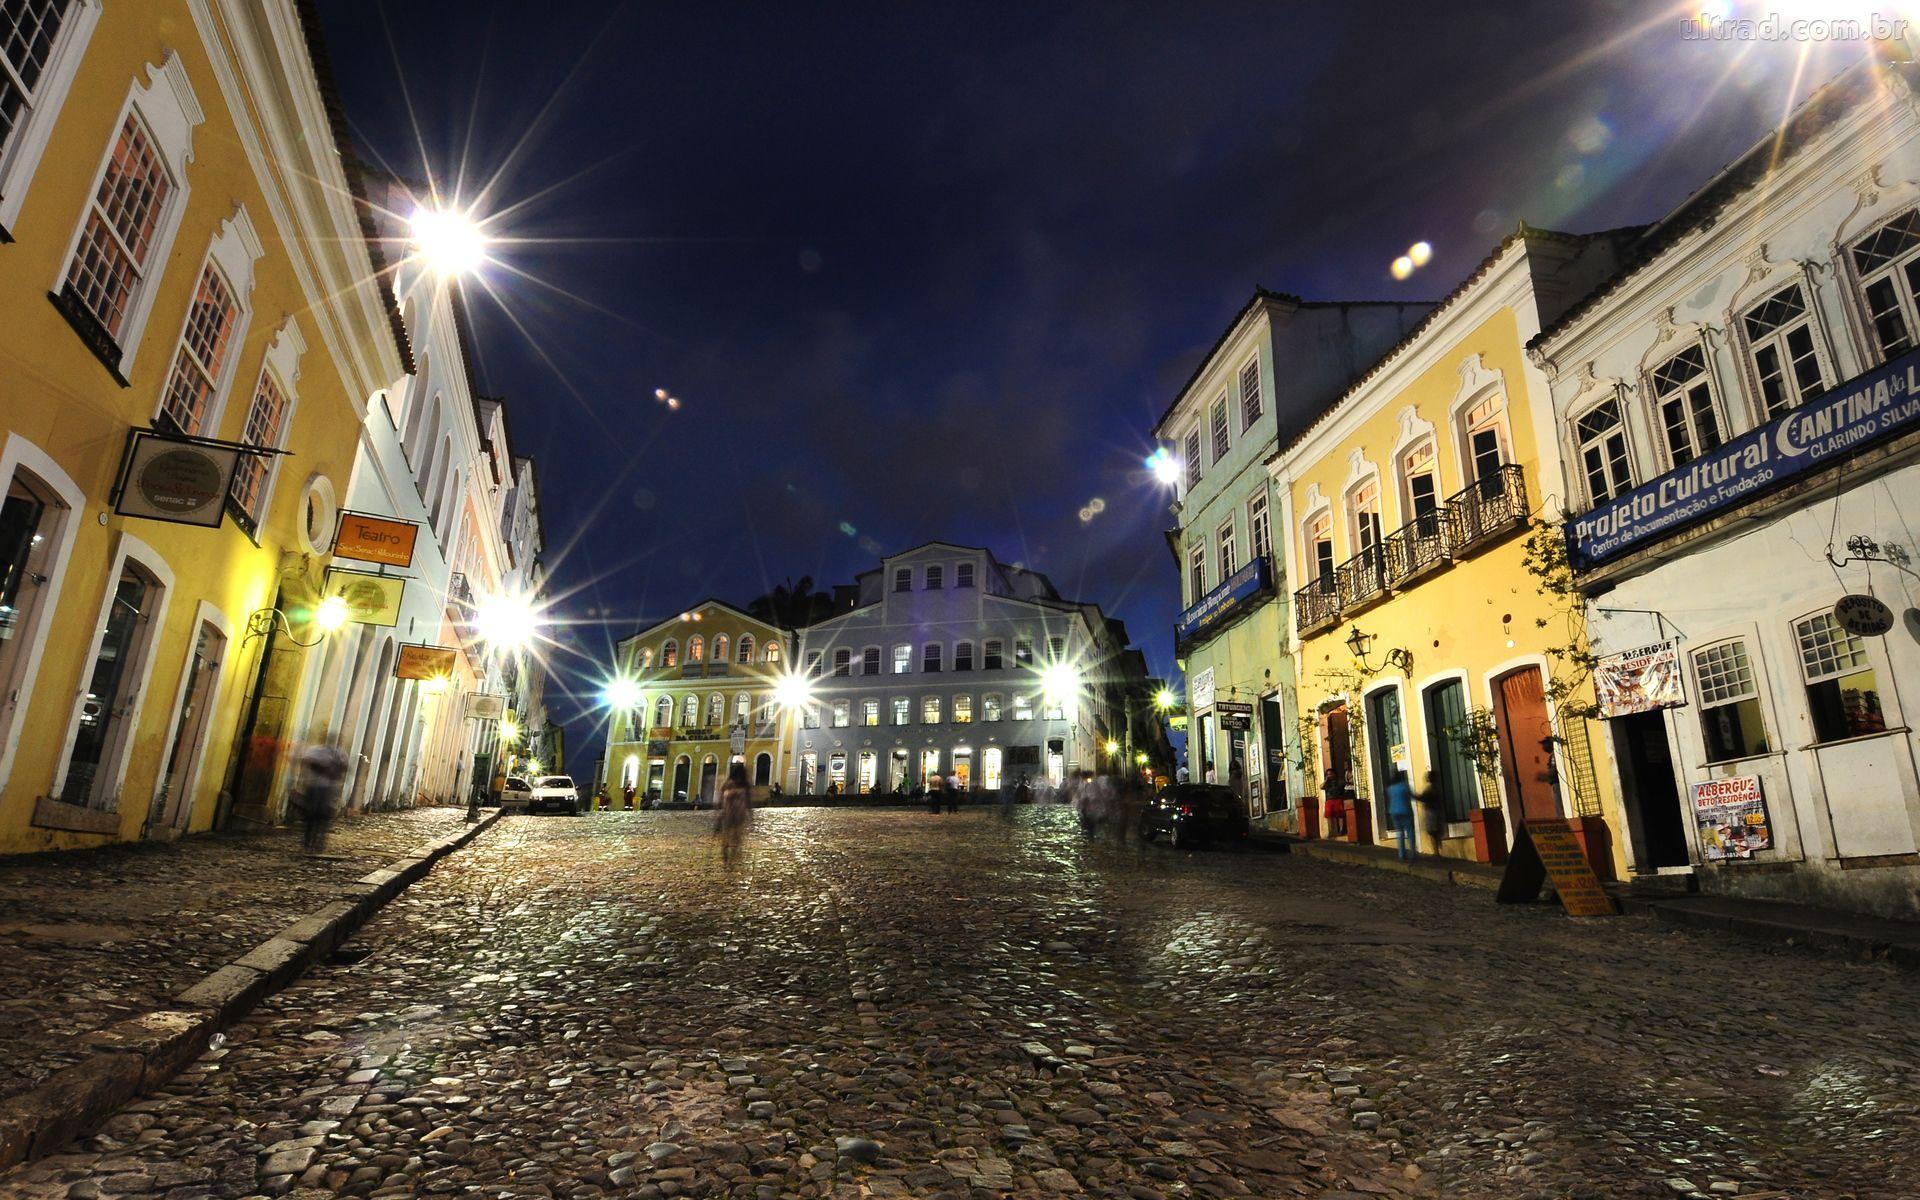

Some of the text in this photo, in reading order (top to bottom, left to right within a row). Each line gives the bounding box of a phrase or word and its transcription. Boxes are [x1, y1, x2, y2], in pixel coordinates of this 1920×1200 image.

[1810, 420, 1877, 458] CLARINDO
[1575, 432, 1769, 549] Projeto Cultural
[1591, 469, 1774, 557] Centro de Documentação e Fundação
[355, 525, 401, 545] Teatro
[1622, 641, 1673, 660] ALBERGUE
[1698, 778, 1755, 798] ALBERGUE
[1697, 798, 1716, 807] BETO
